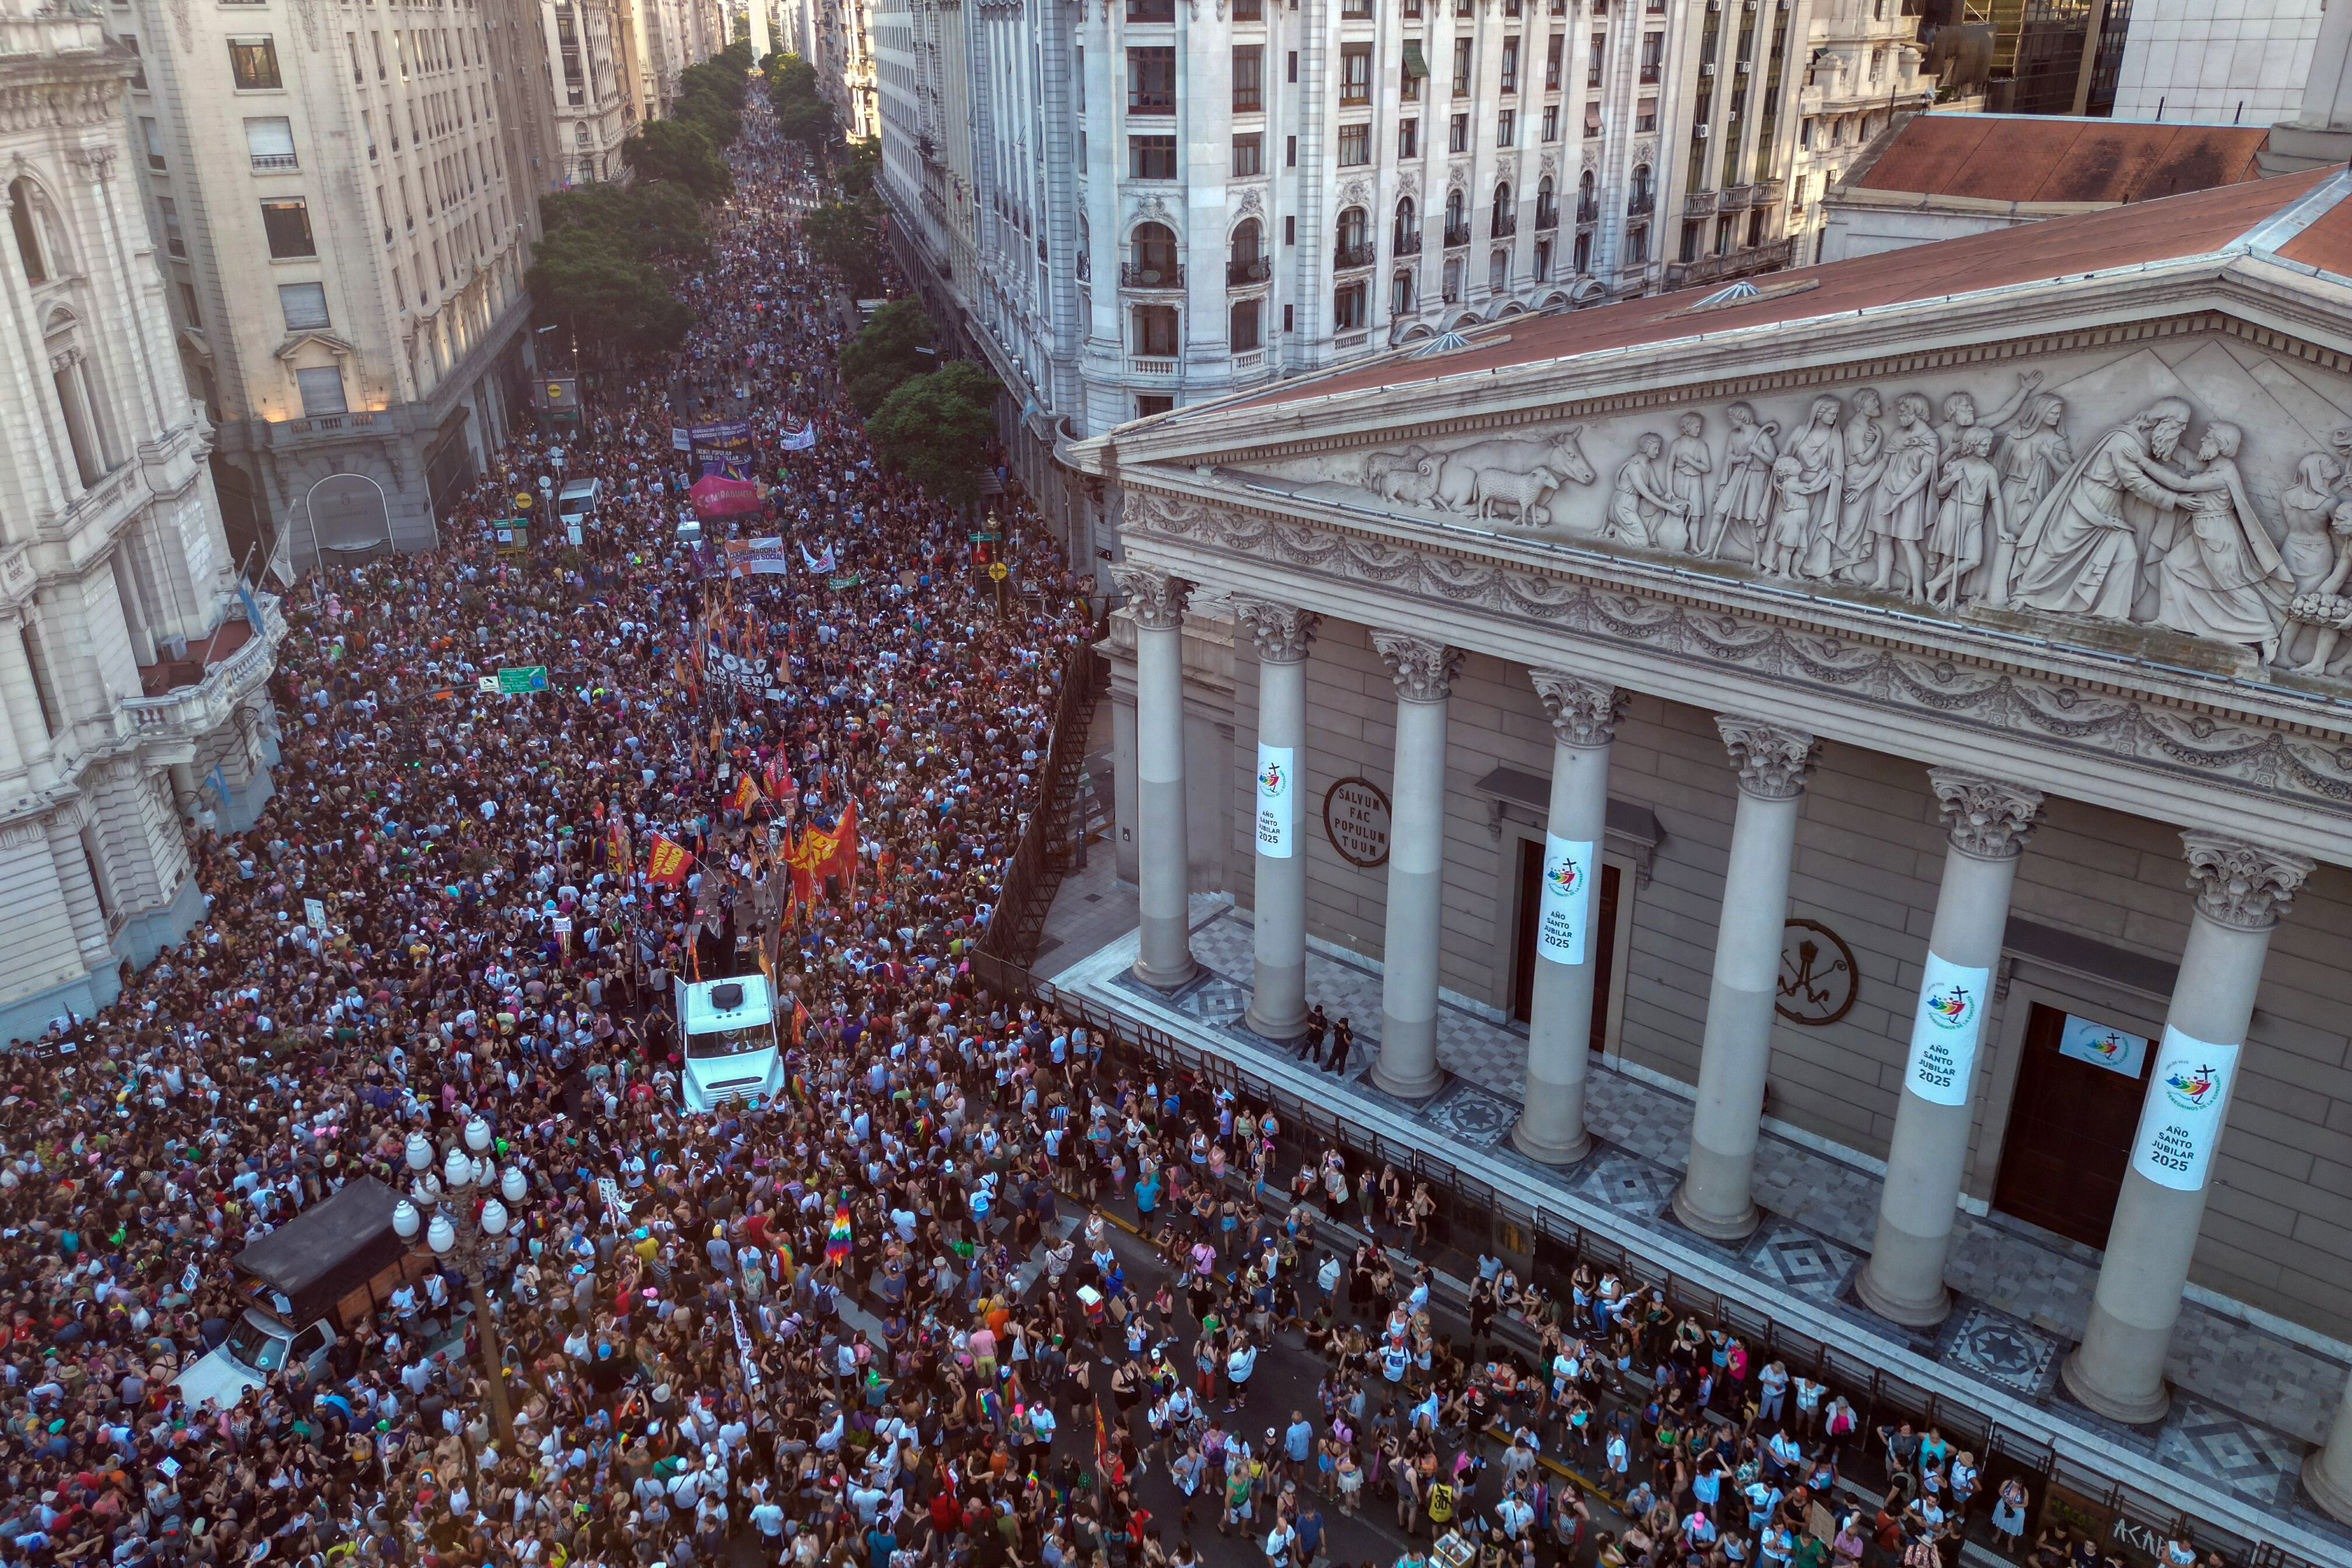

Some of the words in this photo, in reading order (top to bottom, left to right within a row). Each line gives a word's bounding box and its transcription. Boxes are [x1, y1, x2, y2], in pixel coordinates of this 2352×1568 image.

[729, 547, 776, 559] COORDINADORA
[735, 555, 760, 564] CAMBIO
[708, 643, 766, 674] POLO
[1339, 789, 1380, 811] SALVUM
[1260, 817, 1278, 826] SANTO
[1262, 810, 1274, 818] AÑO
[1350, 807, 1370, 823] FAC
[1259, 824, 1280, 834] JUBILAR
[1335, 818, 1385, 844] POPULUM
[1259, 831, 1279, 844] 2025
[1342, 835, 1376, 856] TUUM
[1547, 917, 1569, 929] SANTO
[1550, 911, 1566, 920] AÑO
[1544, 925, 1572, 938] JUBILAR
[1545, 934, 1569, 949] 2025
[1930, 1045, 1948, 1055] AÑO
[1923, 1051, 1953, 1066] SANTO
[1918, 1058, 1955, 1076] JUBILAR
[1919, 1069, 1951, 1087] 2025
[2166, 1125, 2189, 1138] AÑO
[2158, 1132, 2192, 1149] SANTO
[2151, 1140, 2194, 1159] JUBILAR
[2151, 1151, 2189, 1171] 2025
